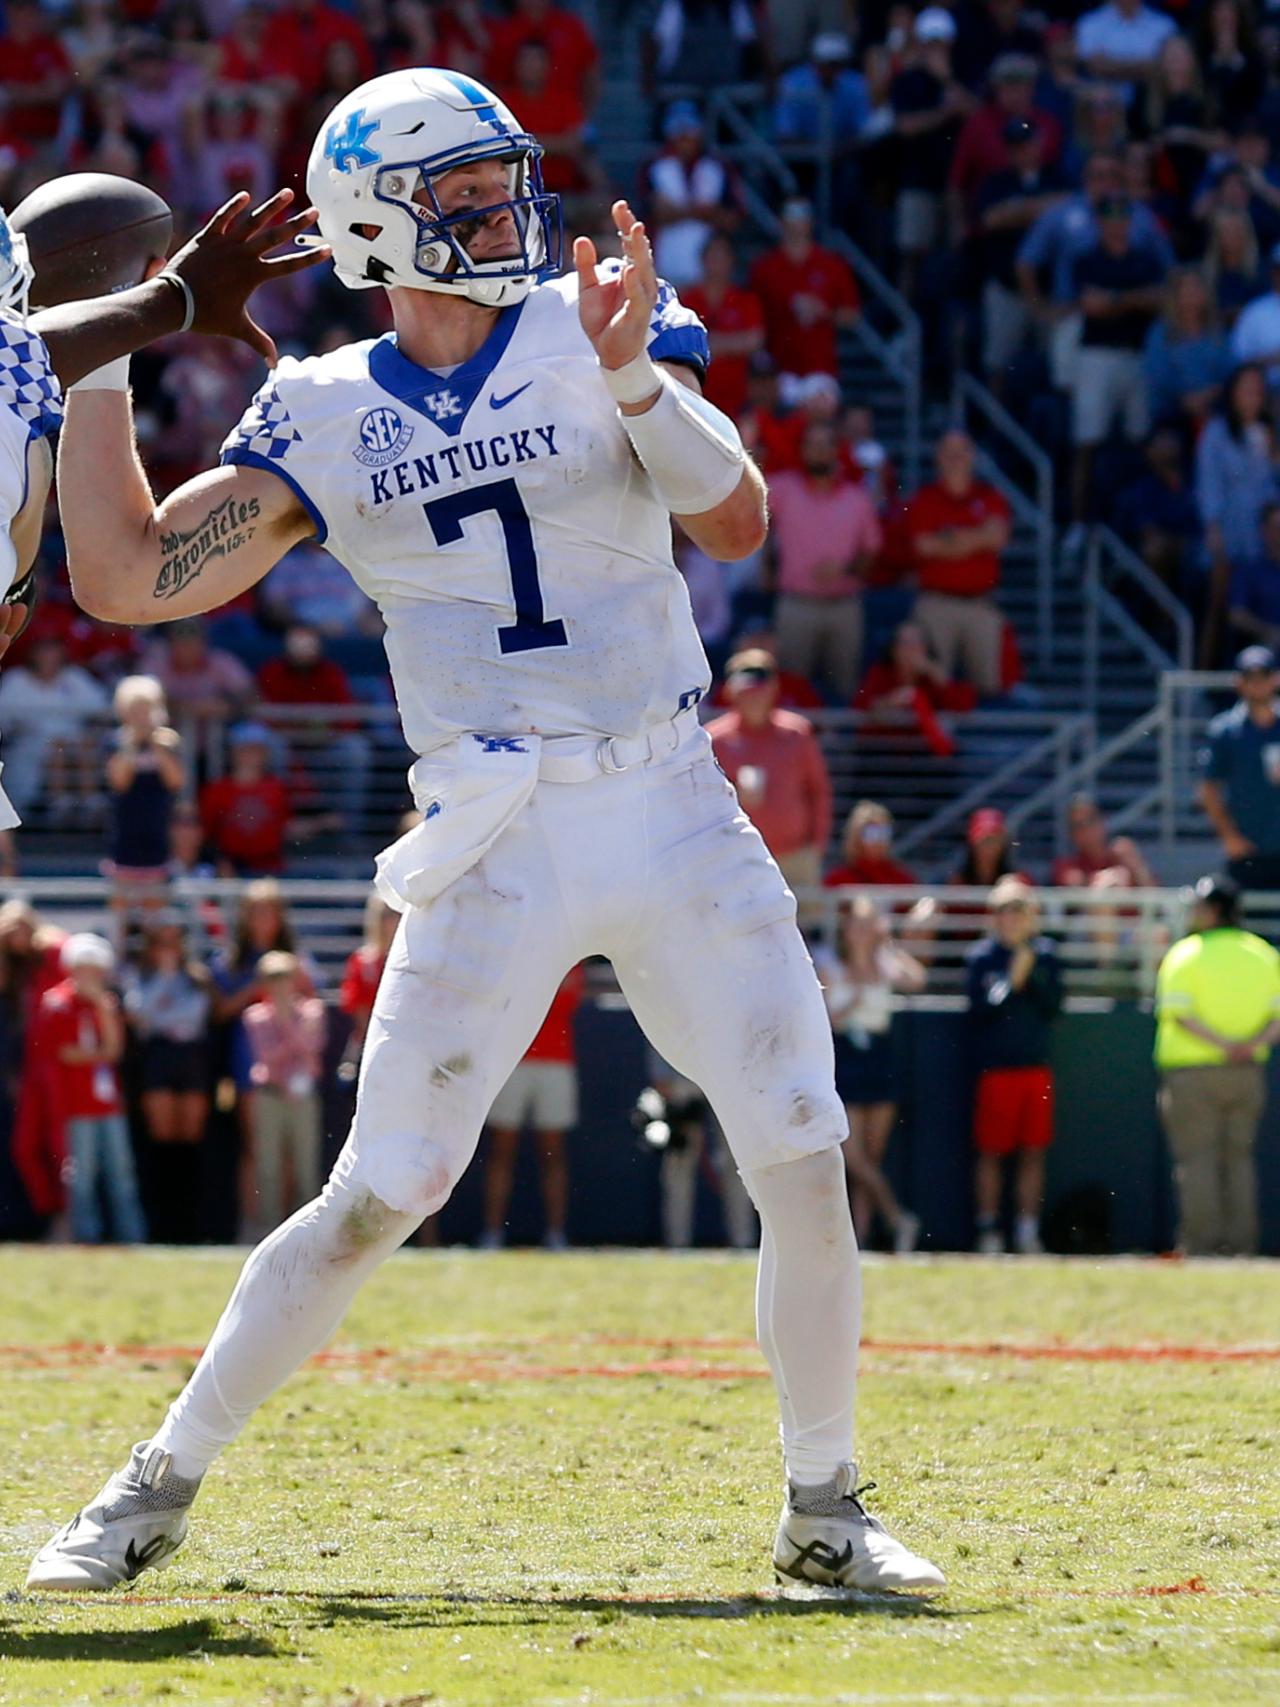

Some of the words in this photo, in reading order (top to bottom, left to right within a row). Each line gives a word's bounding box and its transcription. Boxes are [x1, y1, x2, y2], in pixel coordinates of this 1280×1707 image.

[360, 408, 402, 452] SEC
[423, 389, 464, 421] UK
[370, 424, 560, 505] KENTUCKY
[422, 477, 569, 655] 7
